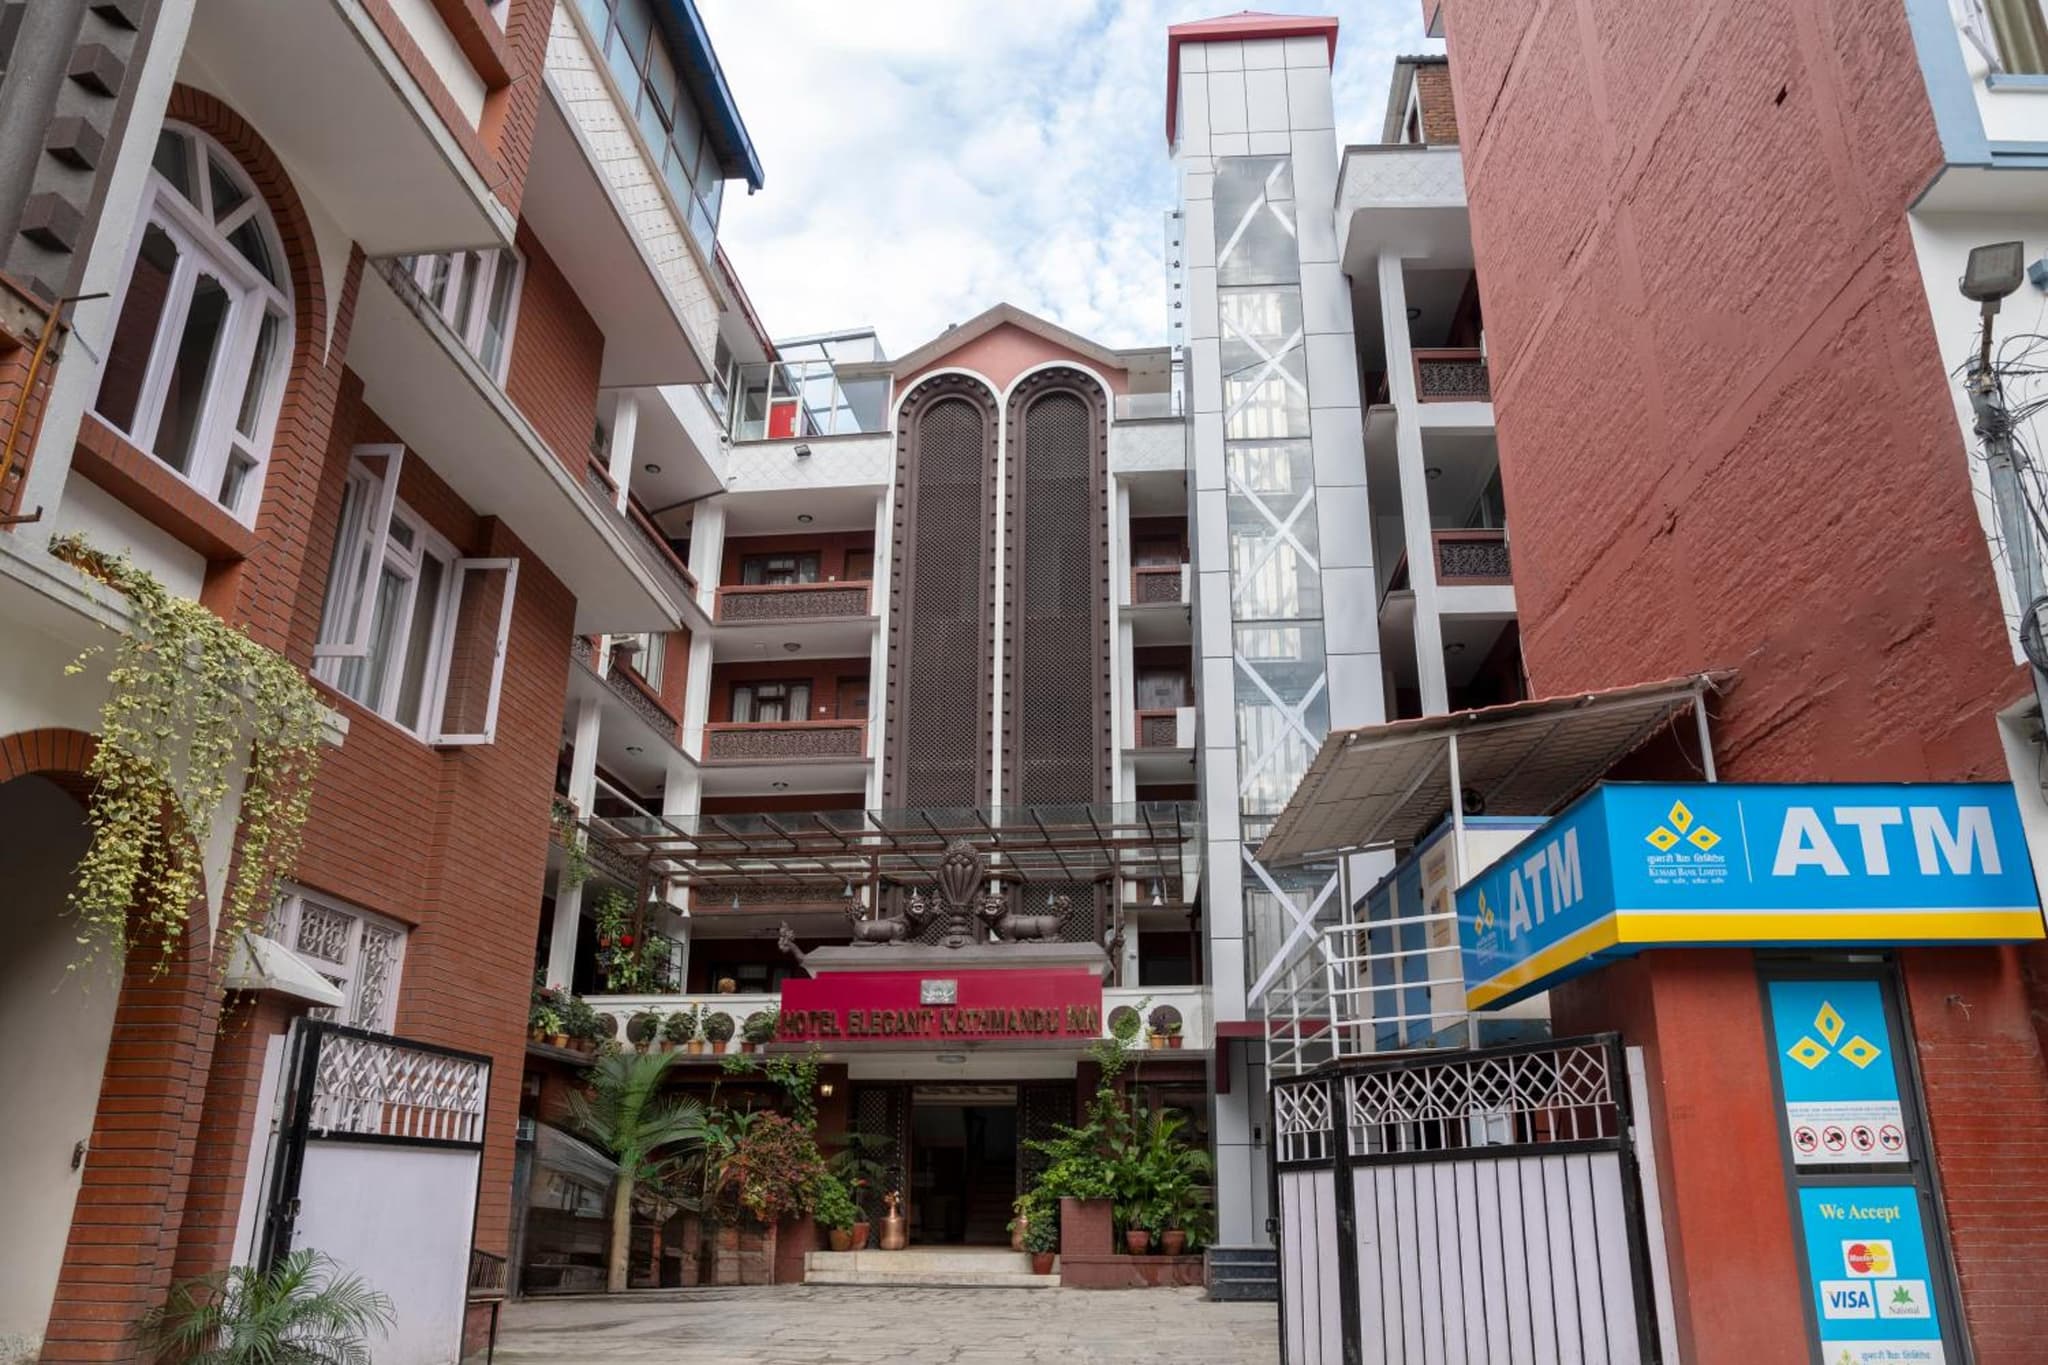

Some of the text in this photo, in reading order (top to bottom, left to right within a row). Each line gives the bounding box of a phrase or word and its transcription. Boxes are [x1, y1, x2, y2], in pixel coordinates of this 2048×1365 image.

[1771, 806, 2003, 876] ATM
[1509, 826, 1584, 941] ATM
[782, 1004, 1099, 1035] HOTEL ELEGANT KATHMANDU INN
[1819, 1204, 1901, 1223] We Accept
[1849, 1253, 1891, 1263] MasterC
[1829, 1291, 1870, 1309] VISA
[1889, 1306, 1921, 1315] National
